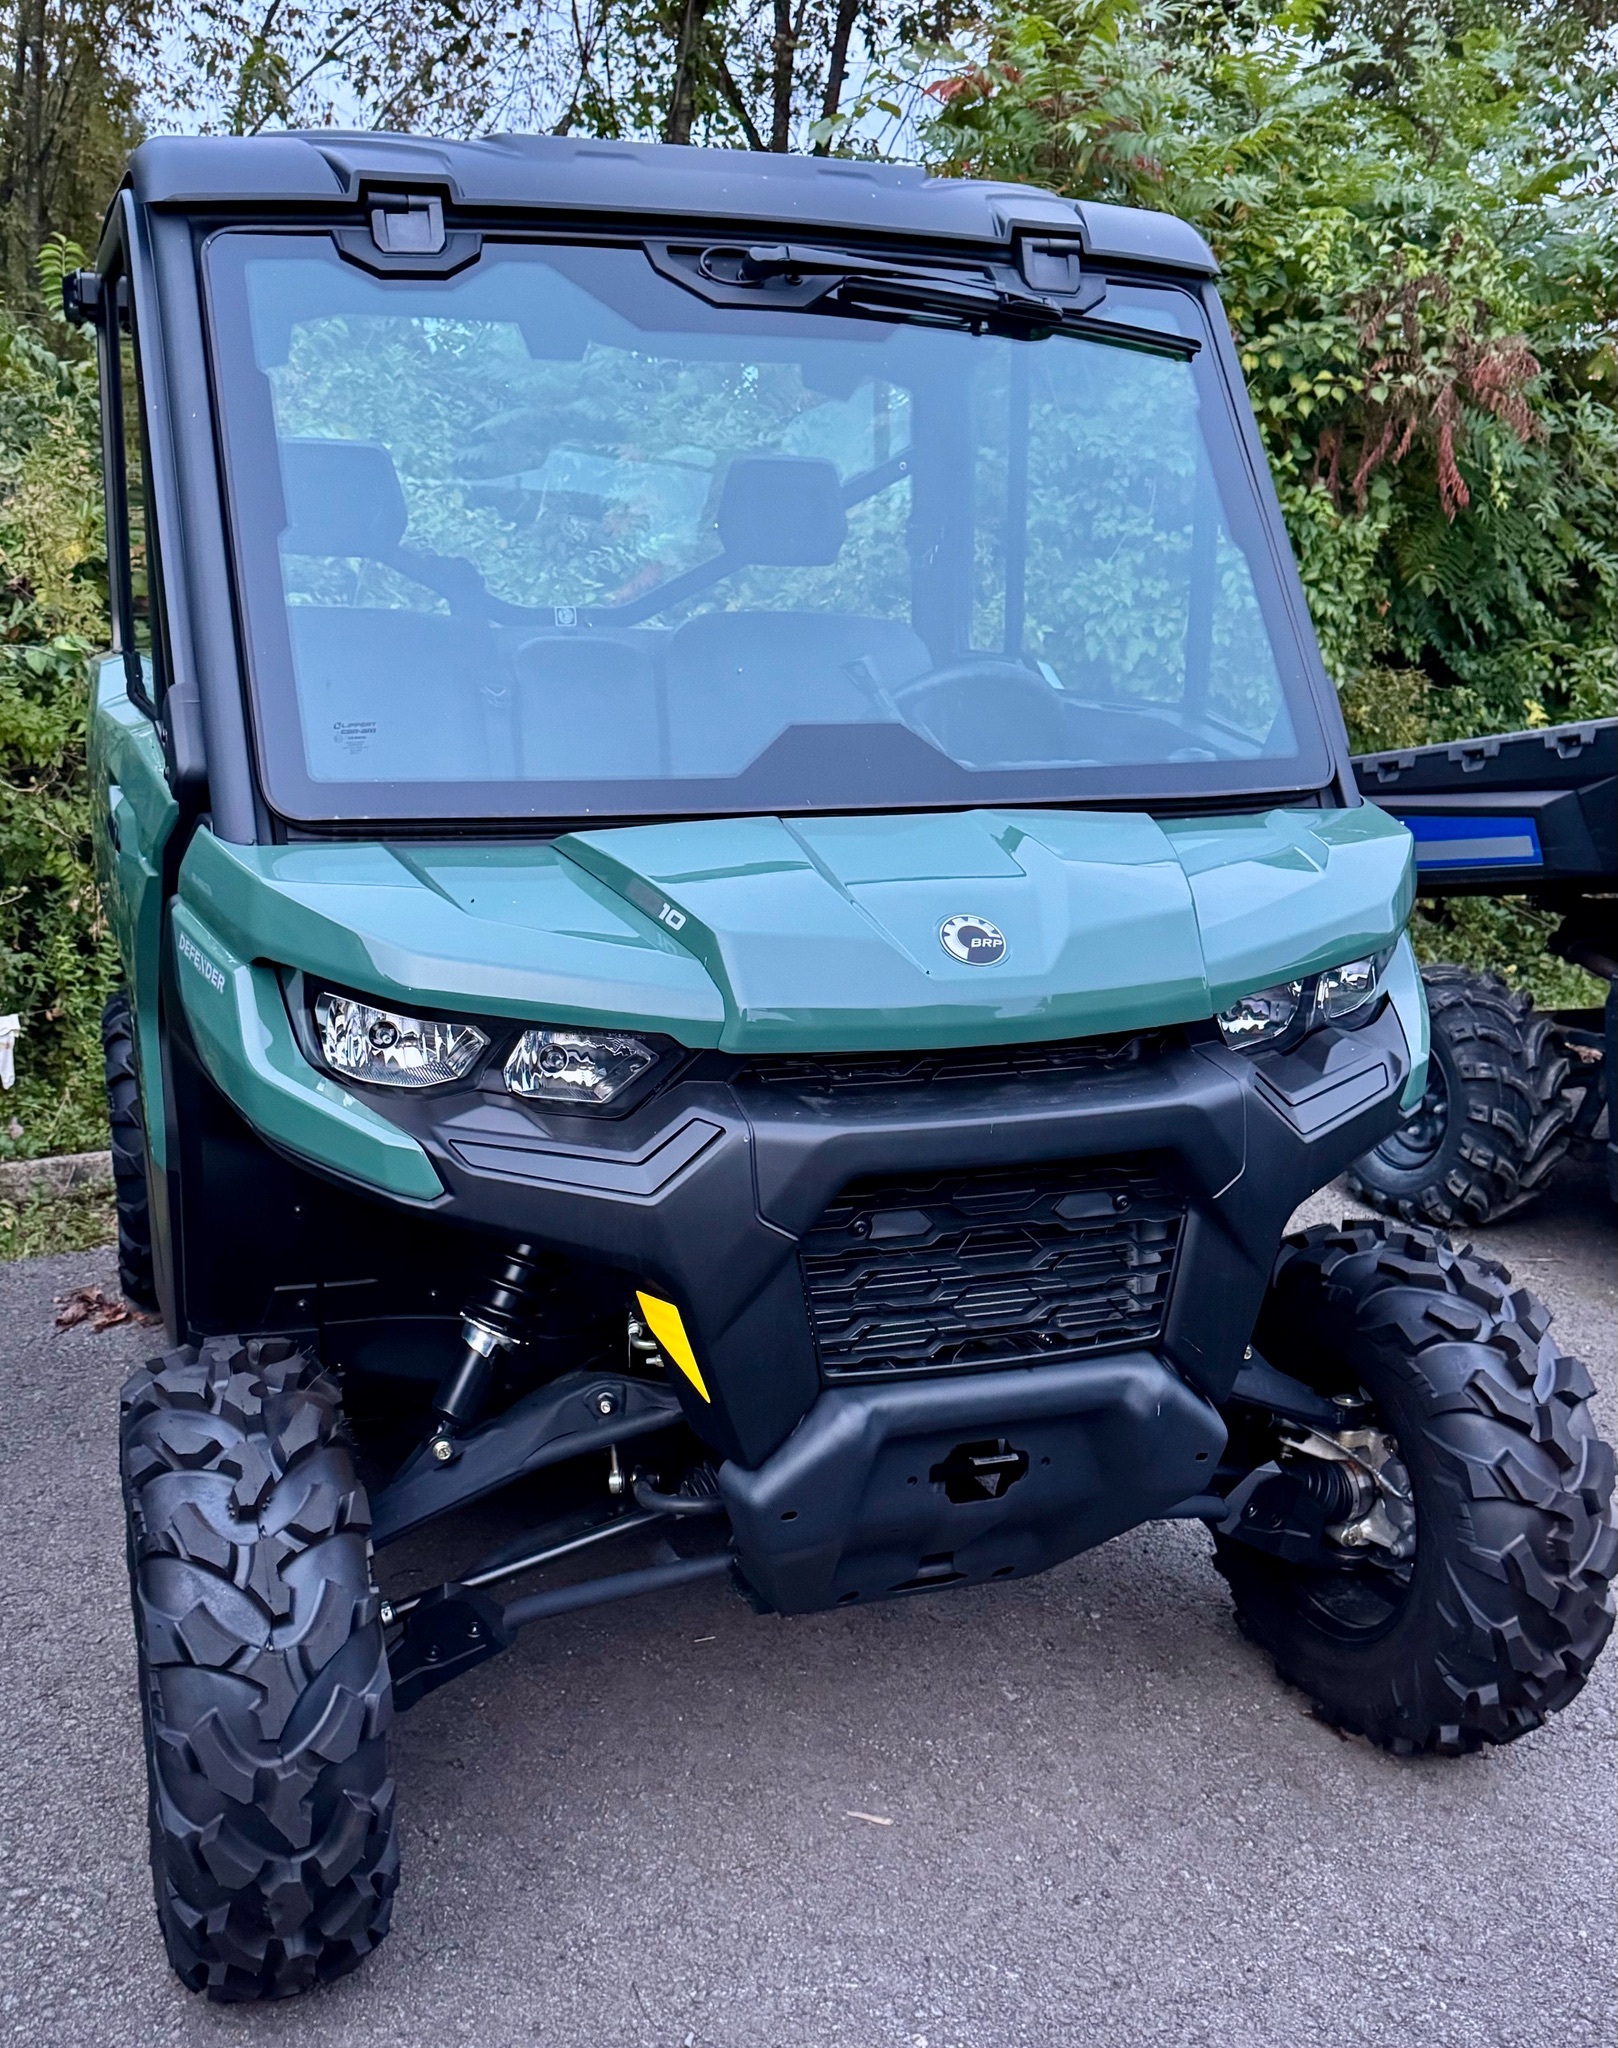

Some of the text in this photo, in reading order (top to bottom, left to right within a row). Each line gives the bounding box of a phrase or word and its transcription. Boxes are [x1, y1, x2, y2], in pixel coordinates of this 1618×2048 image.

[658, 902, 687, 931] 10
[970, 937, 1003, 948] BRP
[179, 932, 225, 994] DEFENDER
